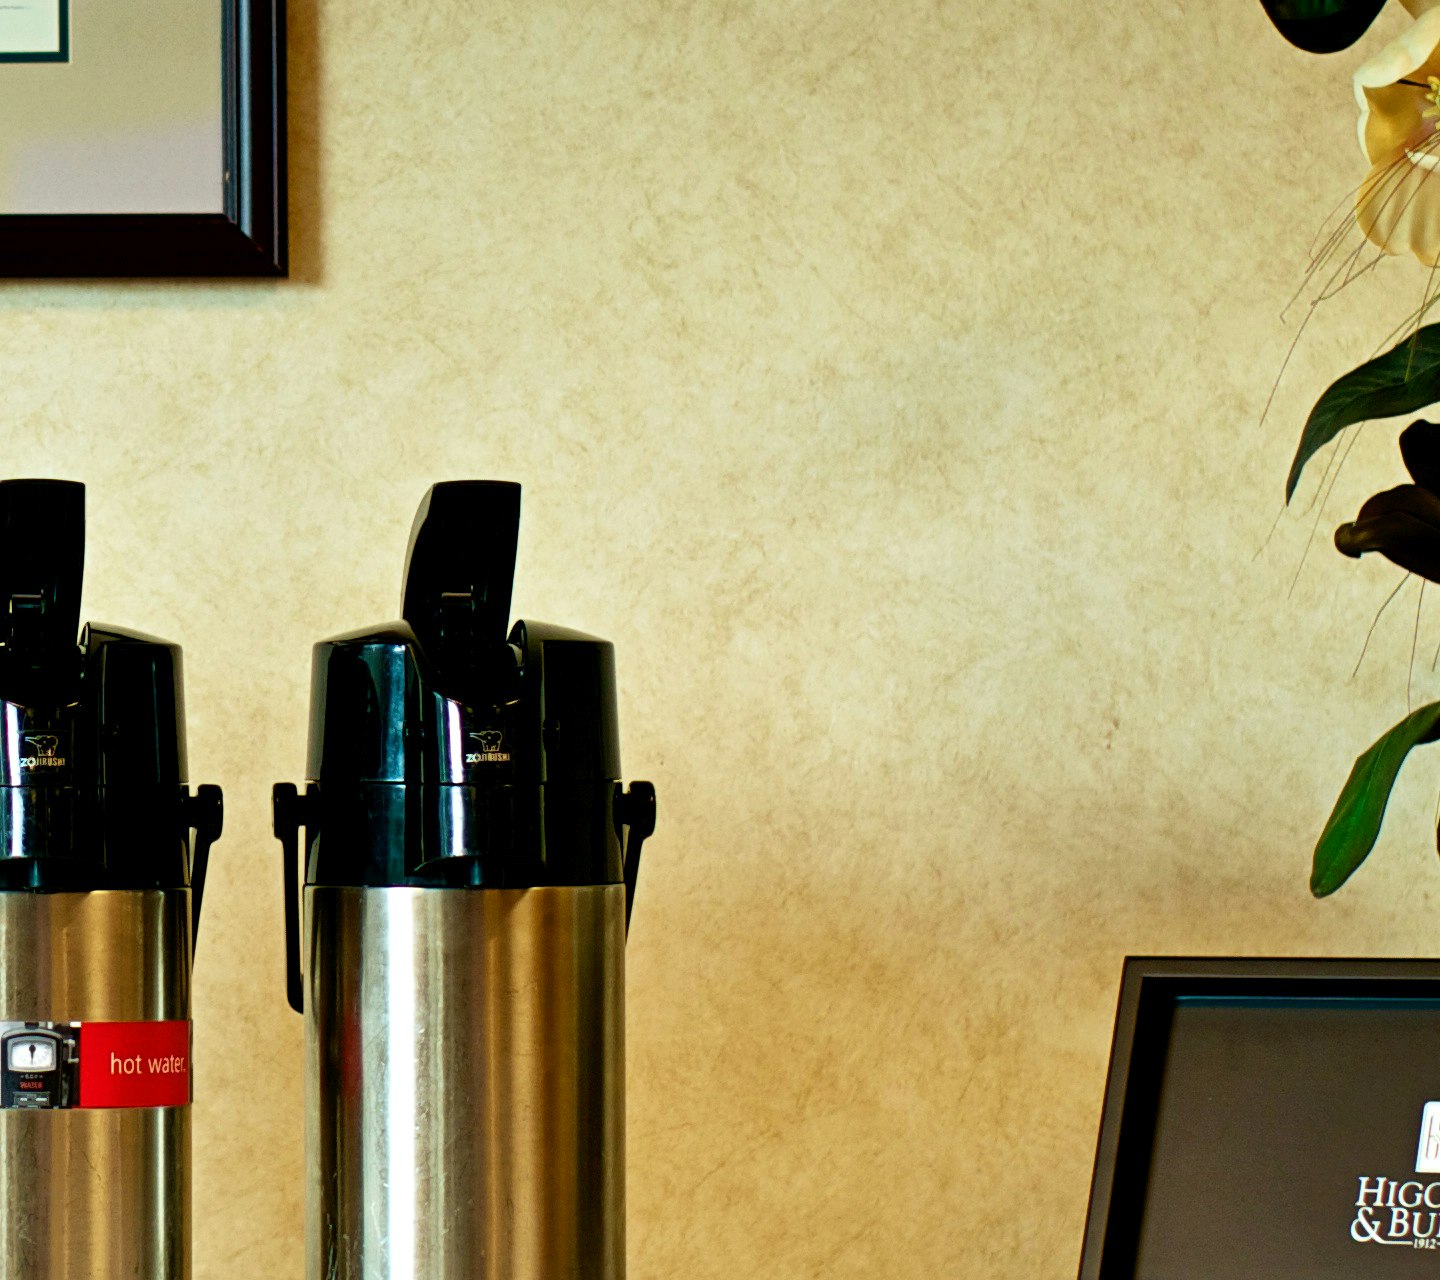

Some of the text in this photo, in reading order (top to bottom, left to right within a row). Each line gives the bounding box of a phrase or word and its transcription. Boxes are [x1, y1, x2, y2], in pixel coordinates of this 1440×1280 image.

[110, 1052, 187, 1075] hot water.
[1350, 1206, 1384, 1243] &
[1413, 1238, 1437, 1249] 1912
